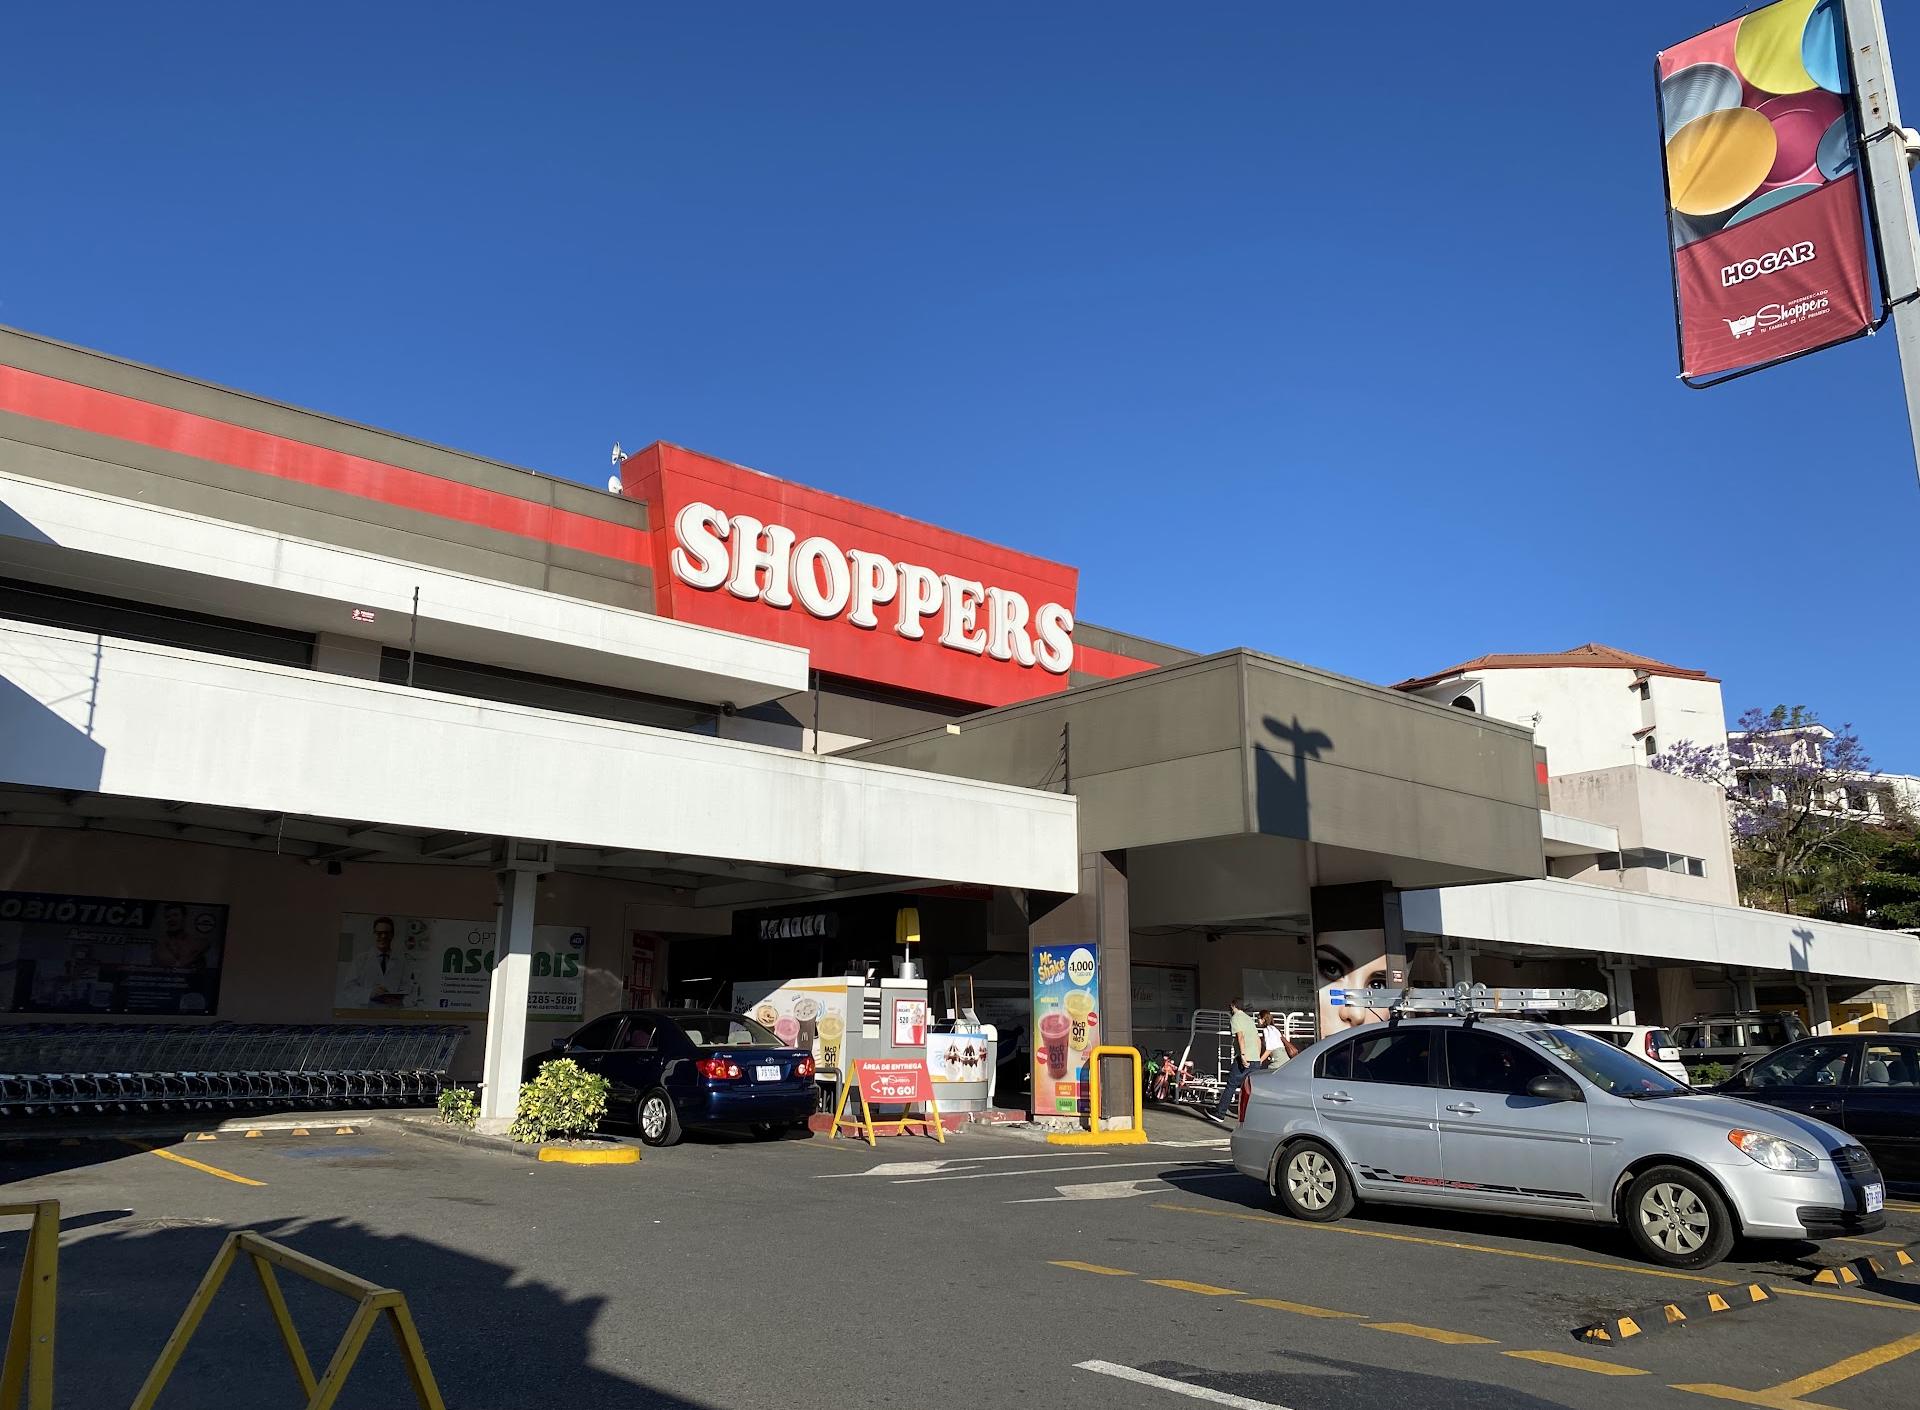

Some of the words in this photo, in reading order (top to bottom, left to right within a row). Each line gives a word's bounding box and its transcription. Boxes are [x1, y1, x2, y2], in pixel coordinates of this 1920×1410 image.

[1721, 241, 1817, 287] HOGAR
[1757, 297, 1829, 327] Shoppers
[1768, 322, 1789, 331] FAMILIA
[671, 501, 1075, 675] SHOPPERS
[1072, 1020, 1086, 1028] McD
[1072, 1027, 1085, 1037] on
[824, 1052, 836, 1062] on
[862, 1062, 881, 1070] ÁREA
[891, 1062, 923, 1070] ENTREGA
[881, 1086, 895, 1096] TO
[896, 1085, 915, 1096] GO!
